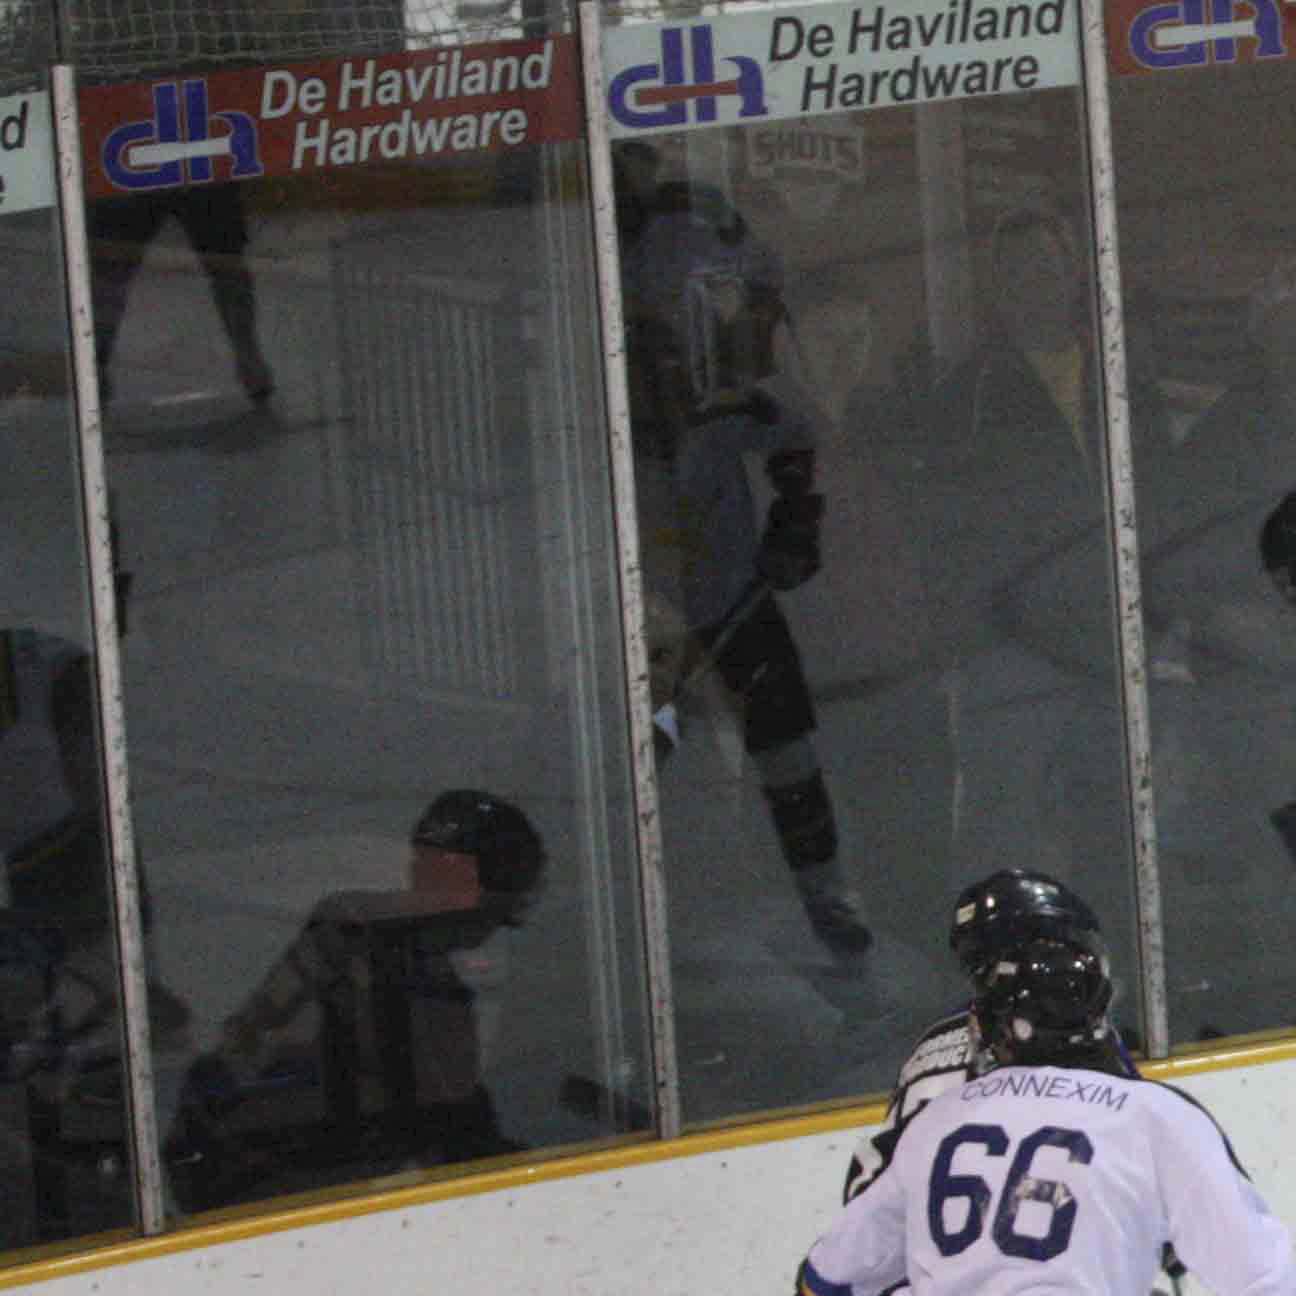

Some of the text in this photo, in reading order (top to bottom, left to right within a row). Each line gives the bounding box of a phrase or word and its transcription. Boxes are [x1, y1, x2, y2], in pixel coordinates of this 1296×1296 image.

[769, 0, 1066, 62] De Haviland
[260, 40, 554, 120] De Haviland
[801, 54, 1040, 112] Hardware
[292, 107, 529, 169] Hardware
[961, 1073, 1129, 1112] CONNEXIM
[927, 1123, 1095, 1263] 66
